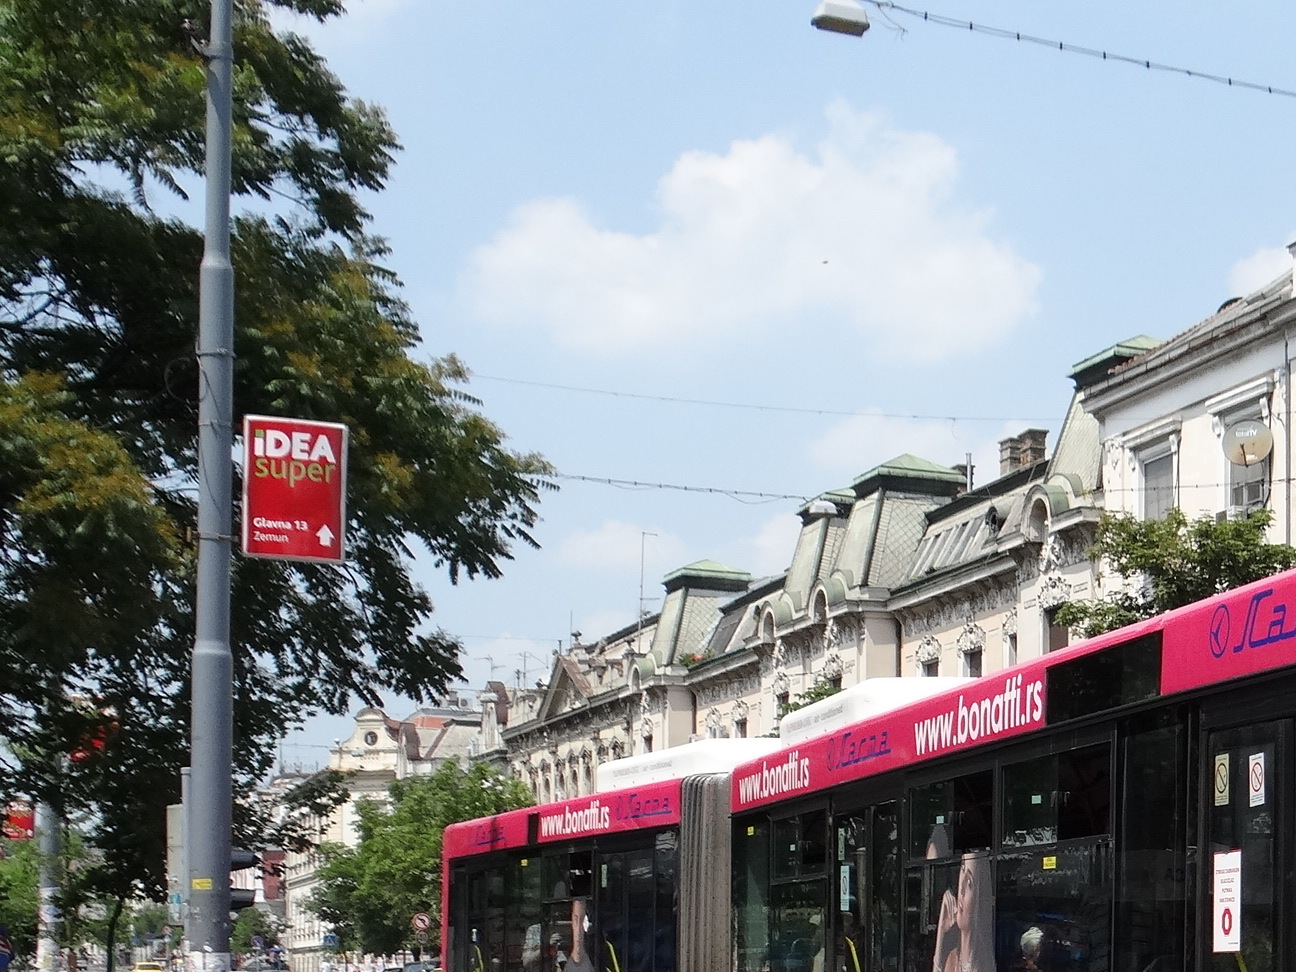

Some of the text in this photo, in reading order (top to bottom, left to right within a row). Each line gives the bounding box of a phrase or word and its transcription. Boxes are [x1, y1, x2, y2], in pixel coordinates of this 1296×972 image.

[254, 457, 336, 488] super
[253, 516, 293, 530] Glavna
[253, 530, 290, 543] Zemun
[914, 673, 1043, 756] www.bonatti.rs
[739, 751, 810, 804] www.bonatti.rs
[540, 799, 610, 838] www.bonatti.rs
